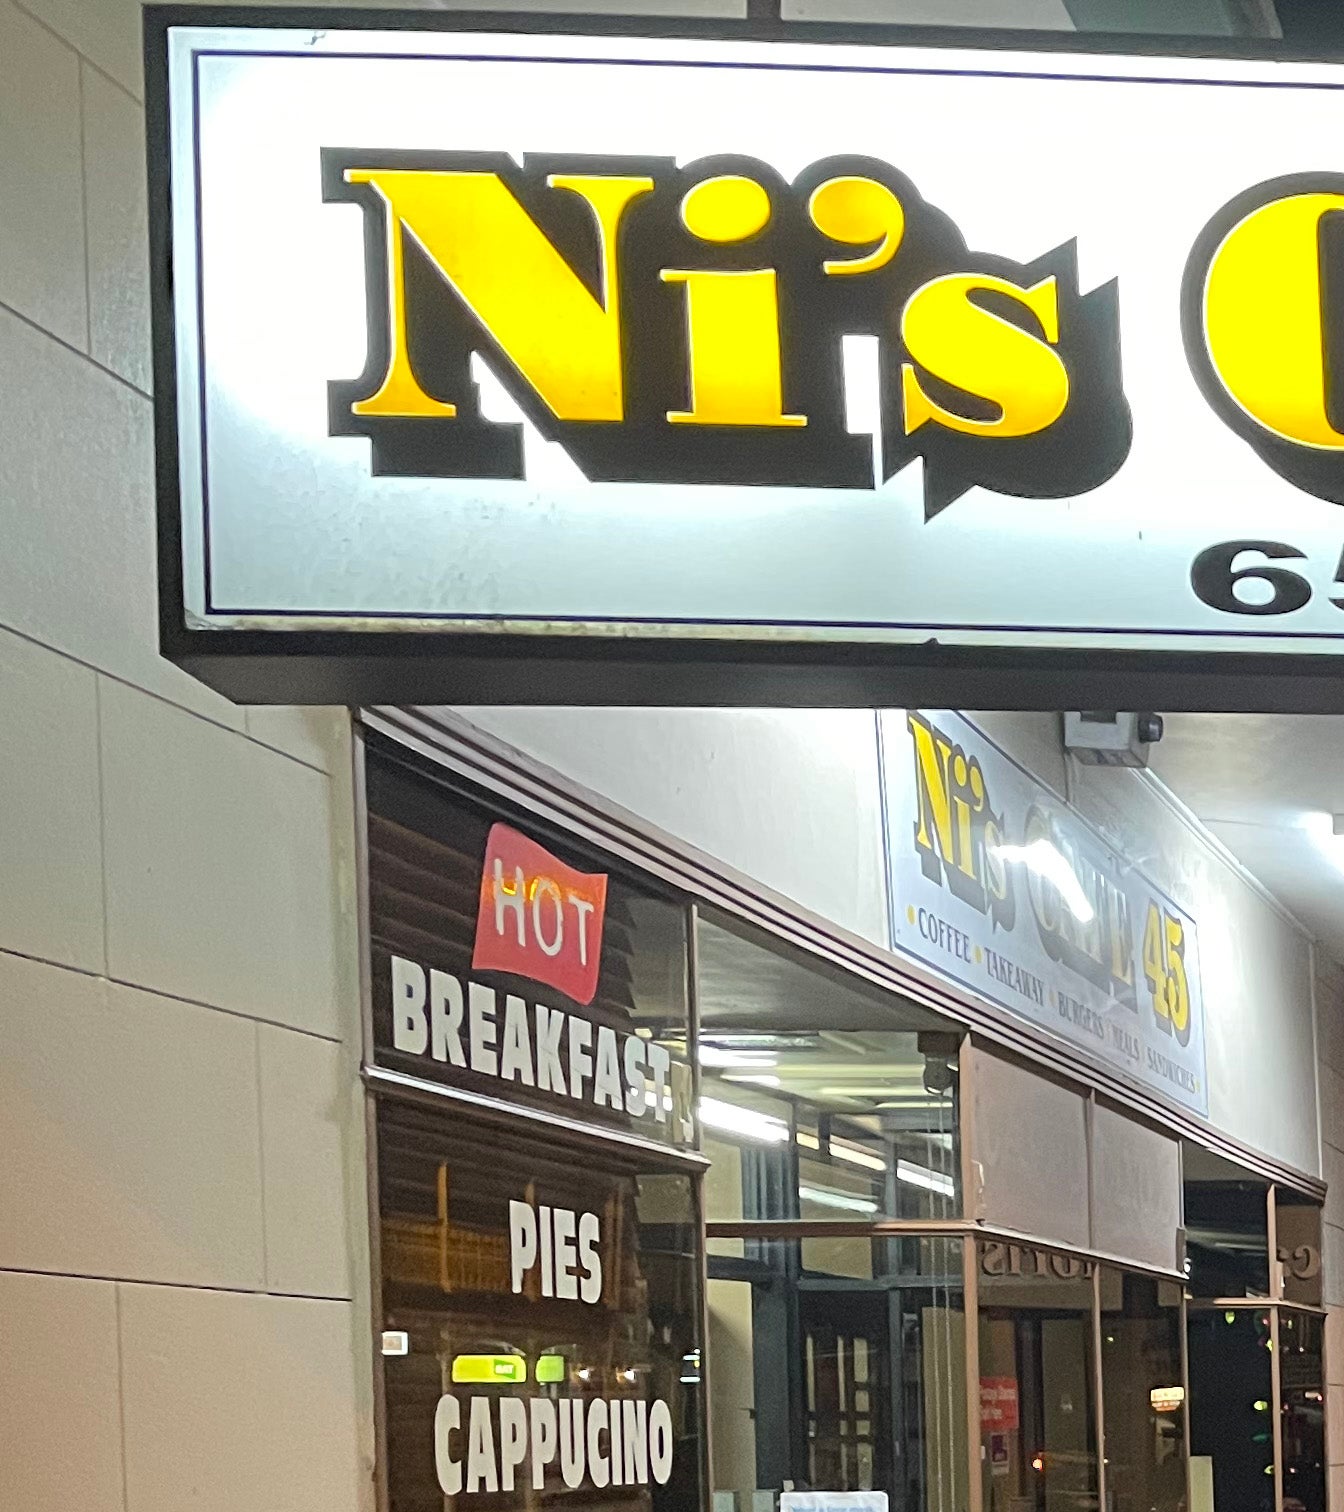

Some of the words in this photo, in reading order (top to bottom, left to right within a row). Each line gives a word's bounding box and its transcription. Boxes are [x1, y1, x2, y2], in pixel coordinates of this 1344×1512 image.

[321, 148, 1131, 510] Ni's
[495, 857, 596, 968] HOT
[1143, 898, 1191, 1047] 45
[391, 956, 670, 1123] BREAKFAST
[918, 907, 972, 965] COFFEE
[983, 946, 1045, 1007] TAKEAWAY
[1057, 991, 1105, 1040] BURGERS
[1111, 1024, 1140, 1059] MEALS
[1146, 1046, 1197, 1094] SANDWICHES
[509, 1200, 600, 1303] PIES
[434, 1394, 674, 1496] CAPPUCINO
